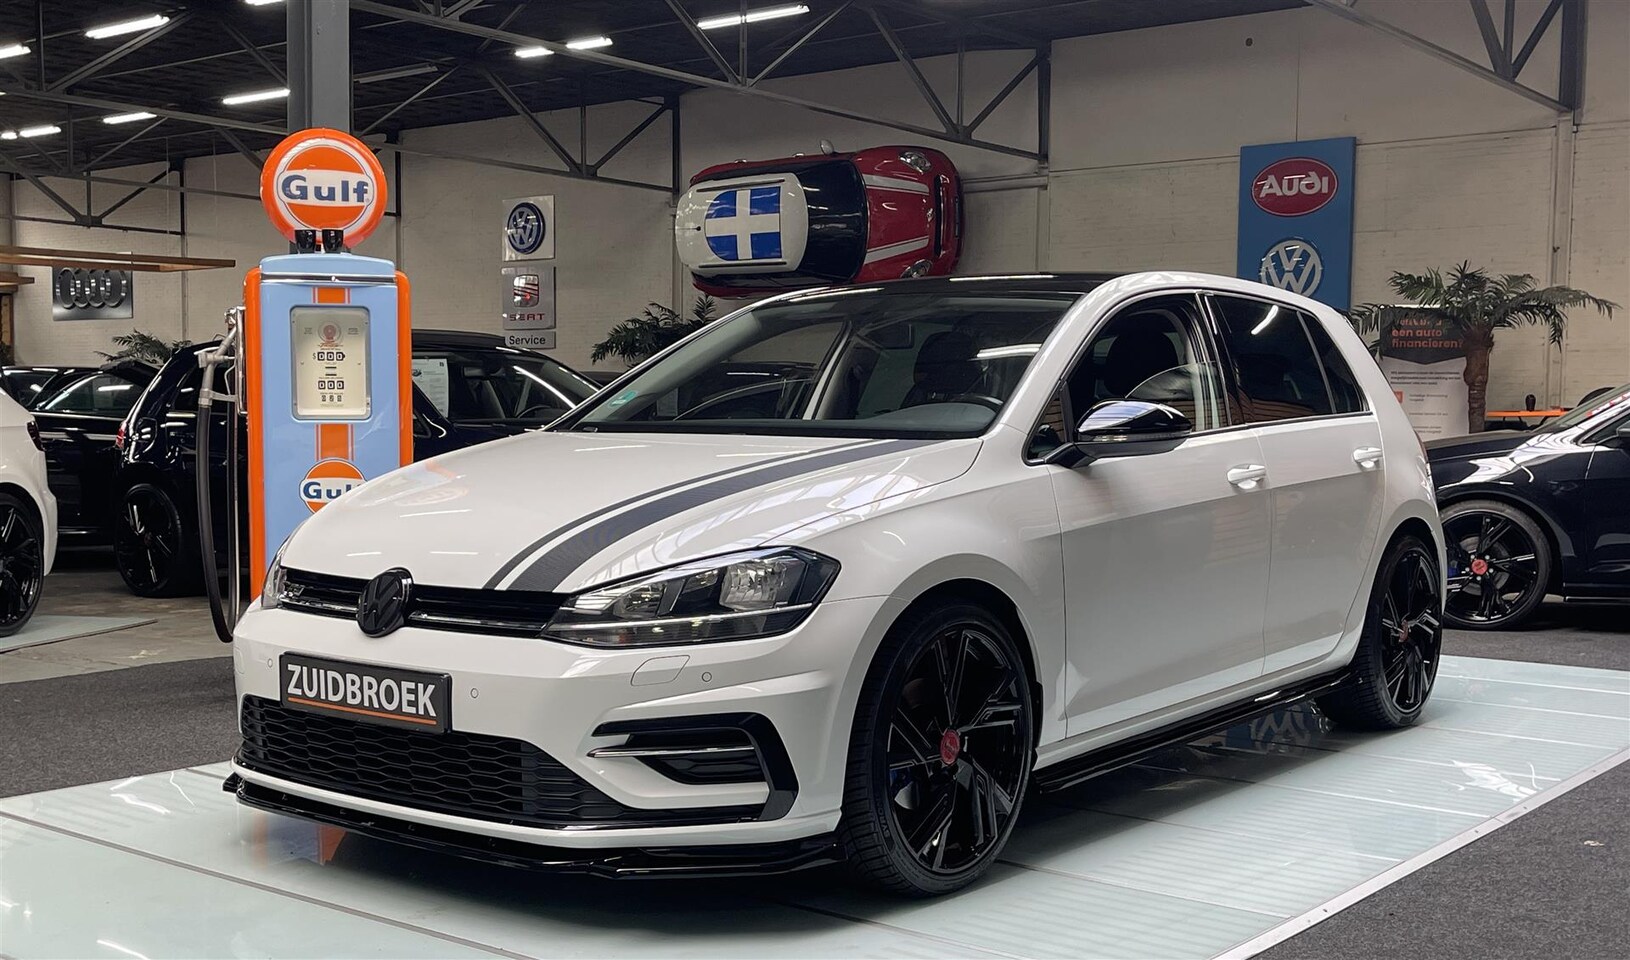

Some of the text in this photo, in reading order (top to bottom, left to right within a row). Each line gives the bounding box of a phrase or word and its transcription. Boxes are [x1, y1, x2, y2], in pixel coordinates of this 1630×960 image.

[281, 174, 369, 203] Gulf
[509, 313, 545, 321] SEAT
[509, 335, 546, 345] Service
[287, 663, 437, 717] ZUIDBROEK
